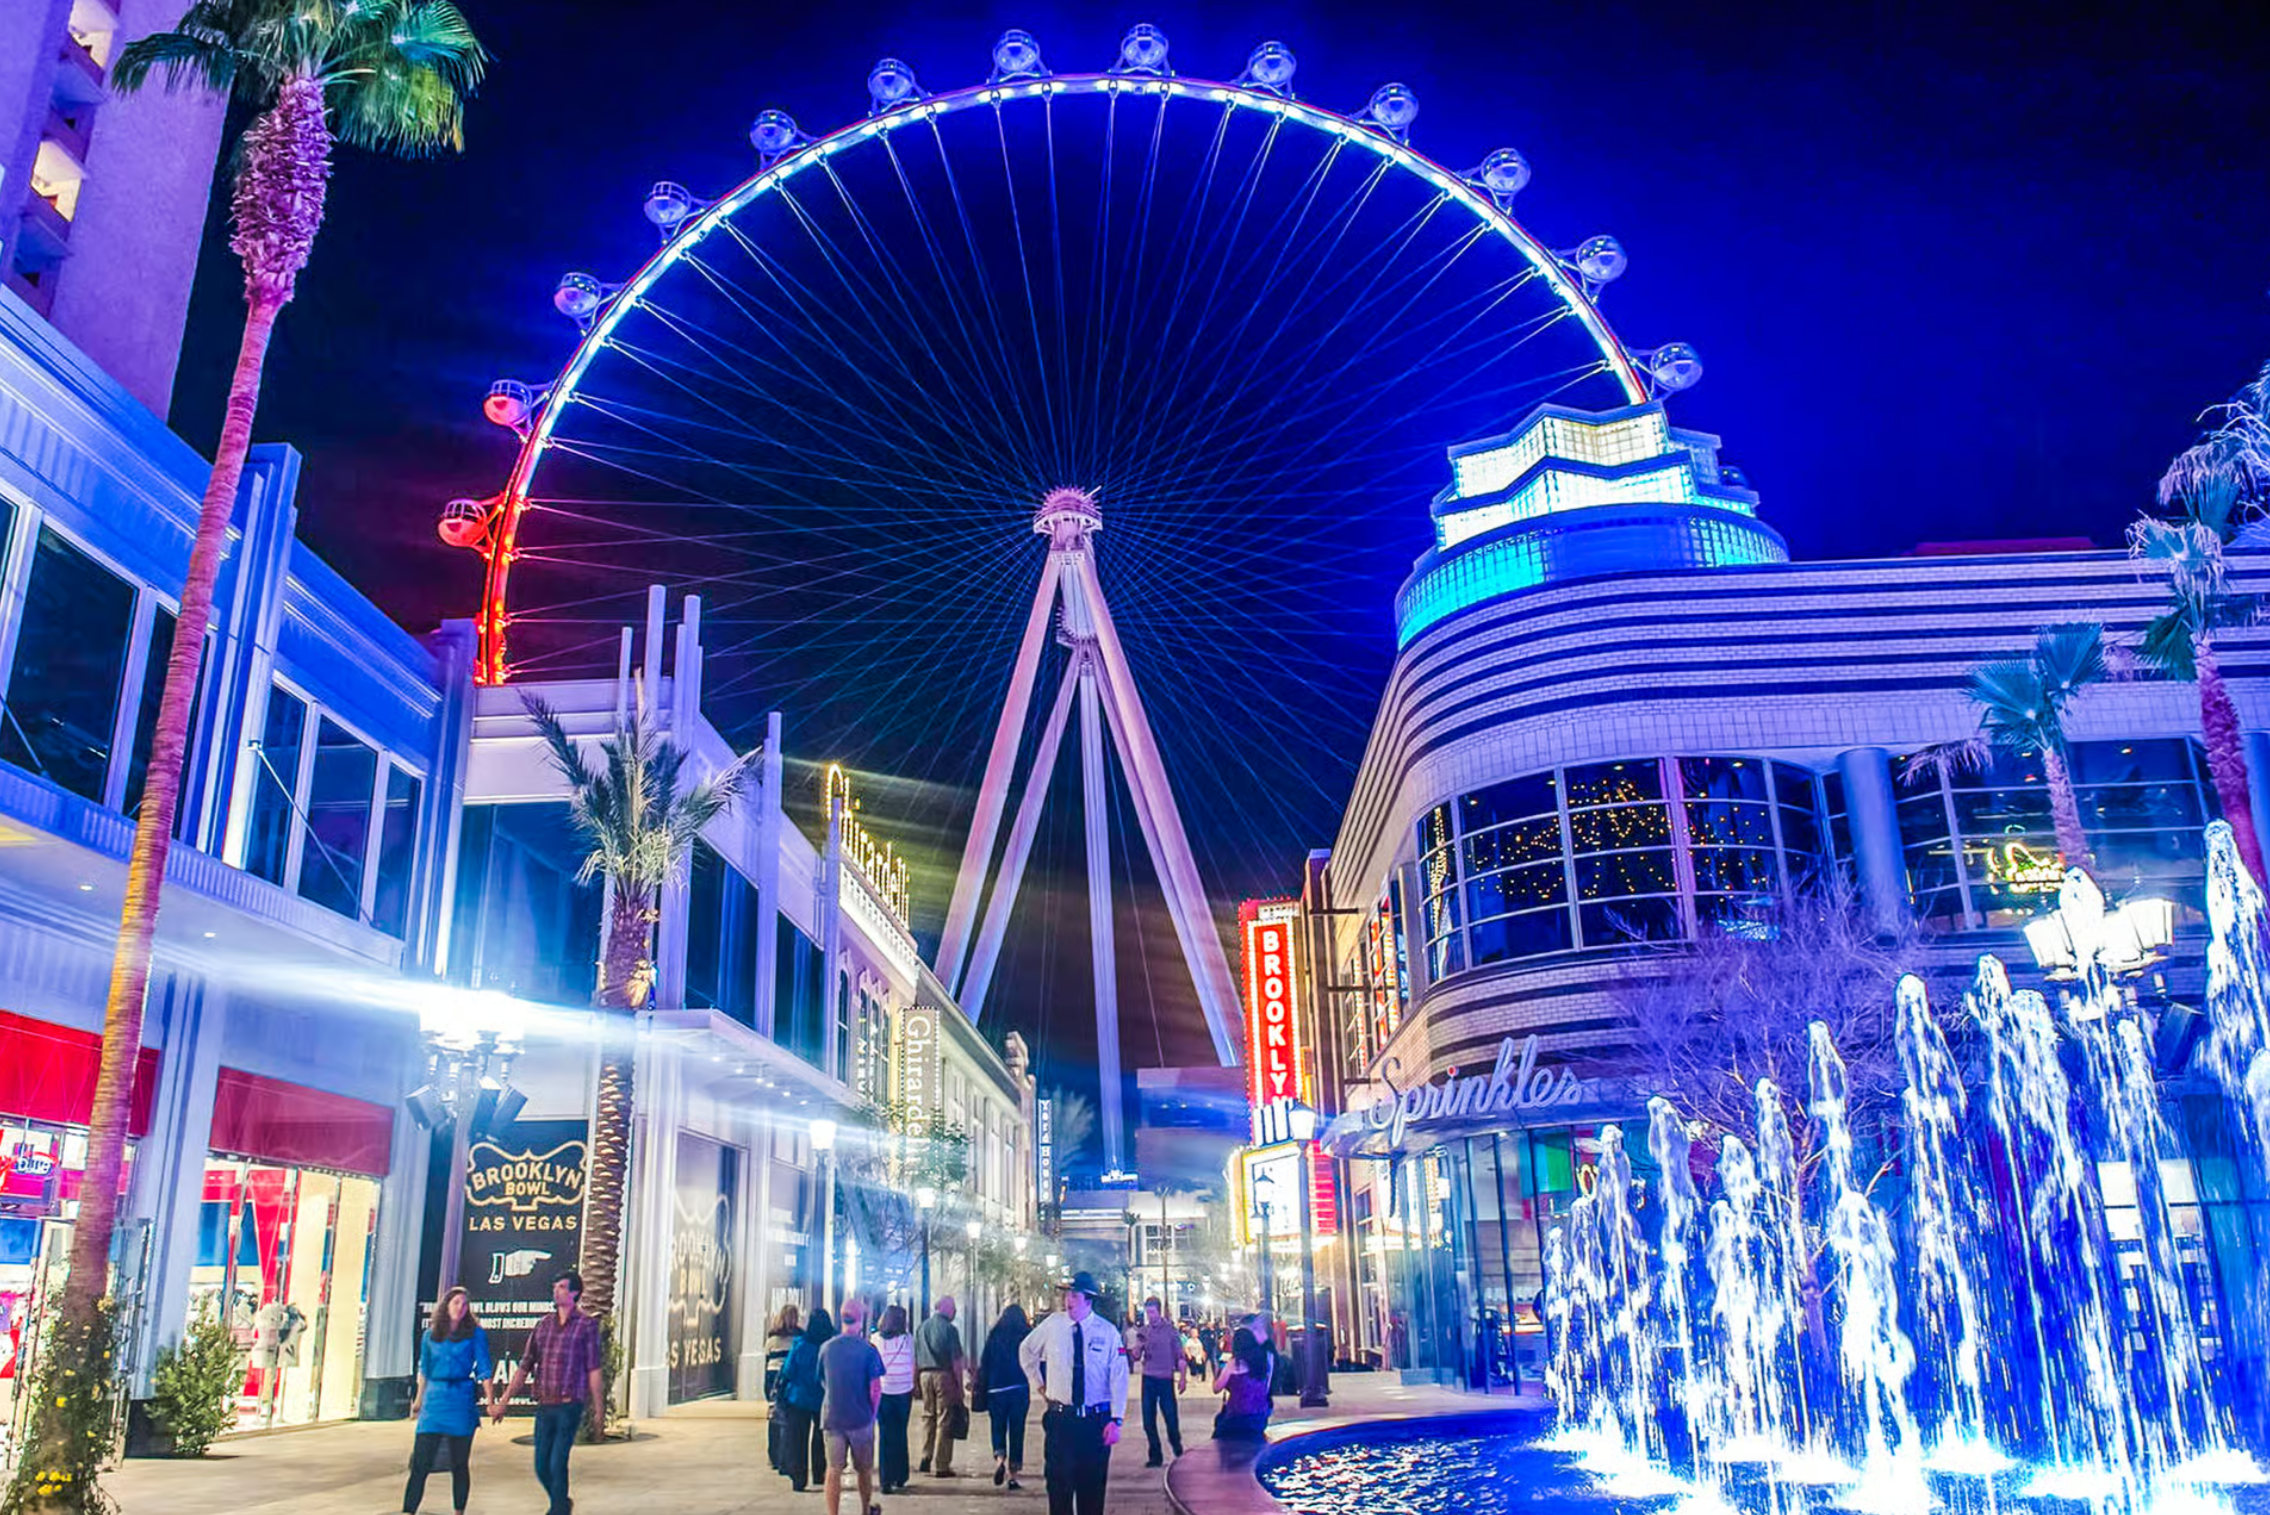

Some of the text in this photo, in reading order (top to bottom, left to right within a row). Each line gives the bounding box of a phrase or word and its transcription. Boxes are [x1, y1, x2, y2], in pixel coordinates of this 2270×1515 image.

[906, 1016, 931, 1164] Ghirardelli
[1369, 1034, 1584, 1148] Sprinkles
[472, 1161, 582, 1191] BROOKLYN
[505, 1181, 550, 1196] BOWL
[469, 1216, 577, 1231] LAS VEGAS
[683, 1337, 721, 1366] VEGAS
